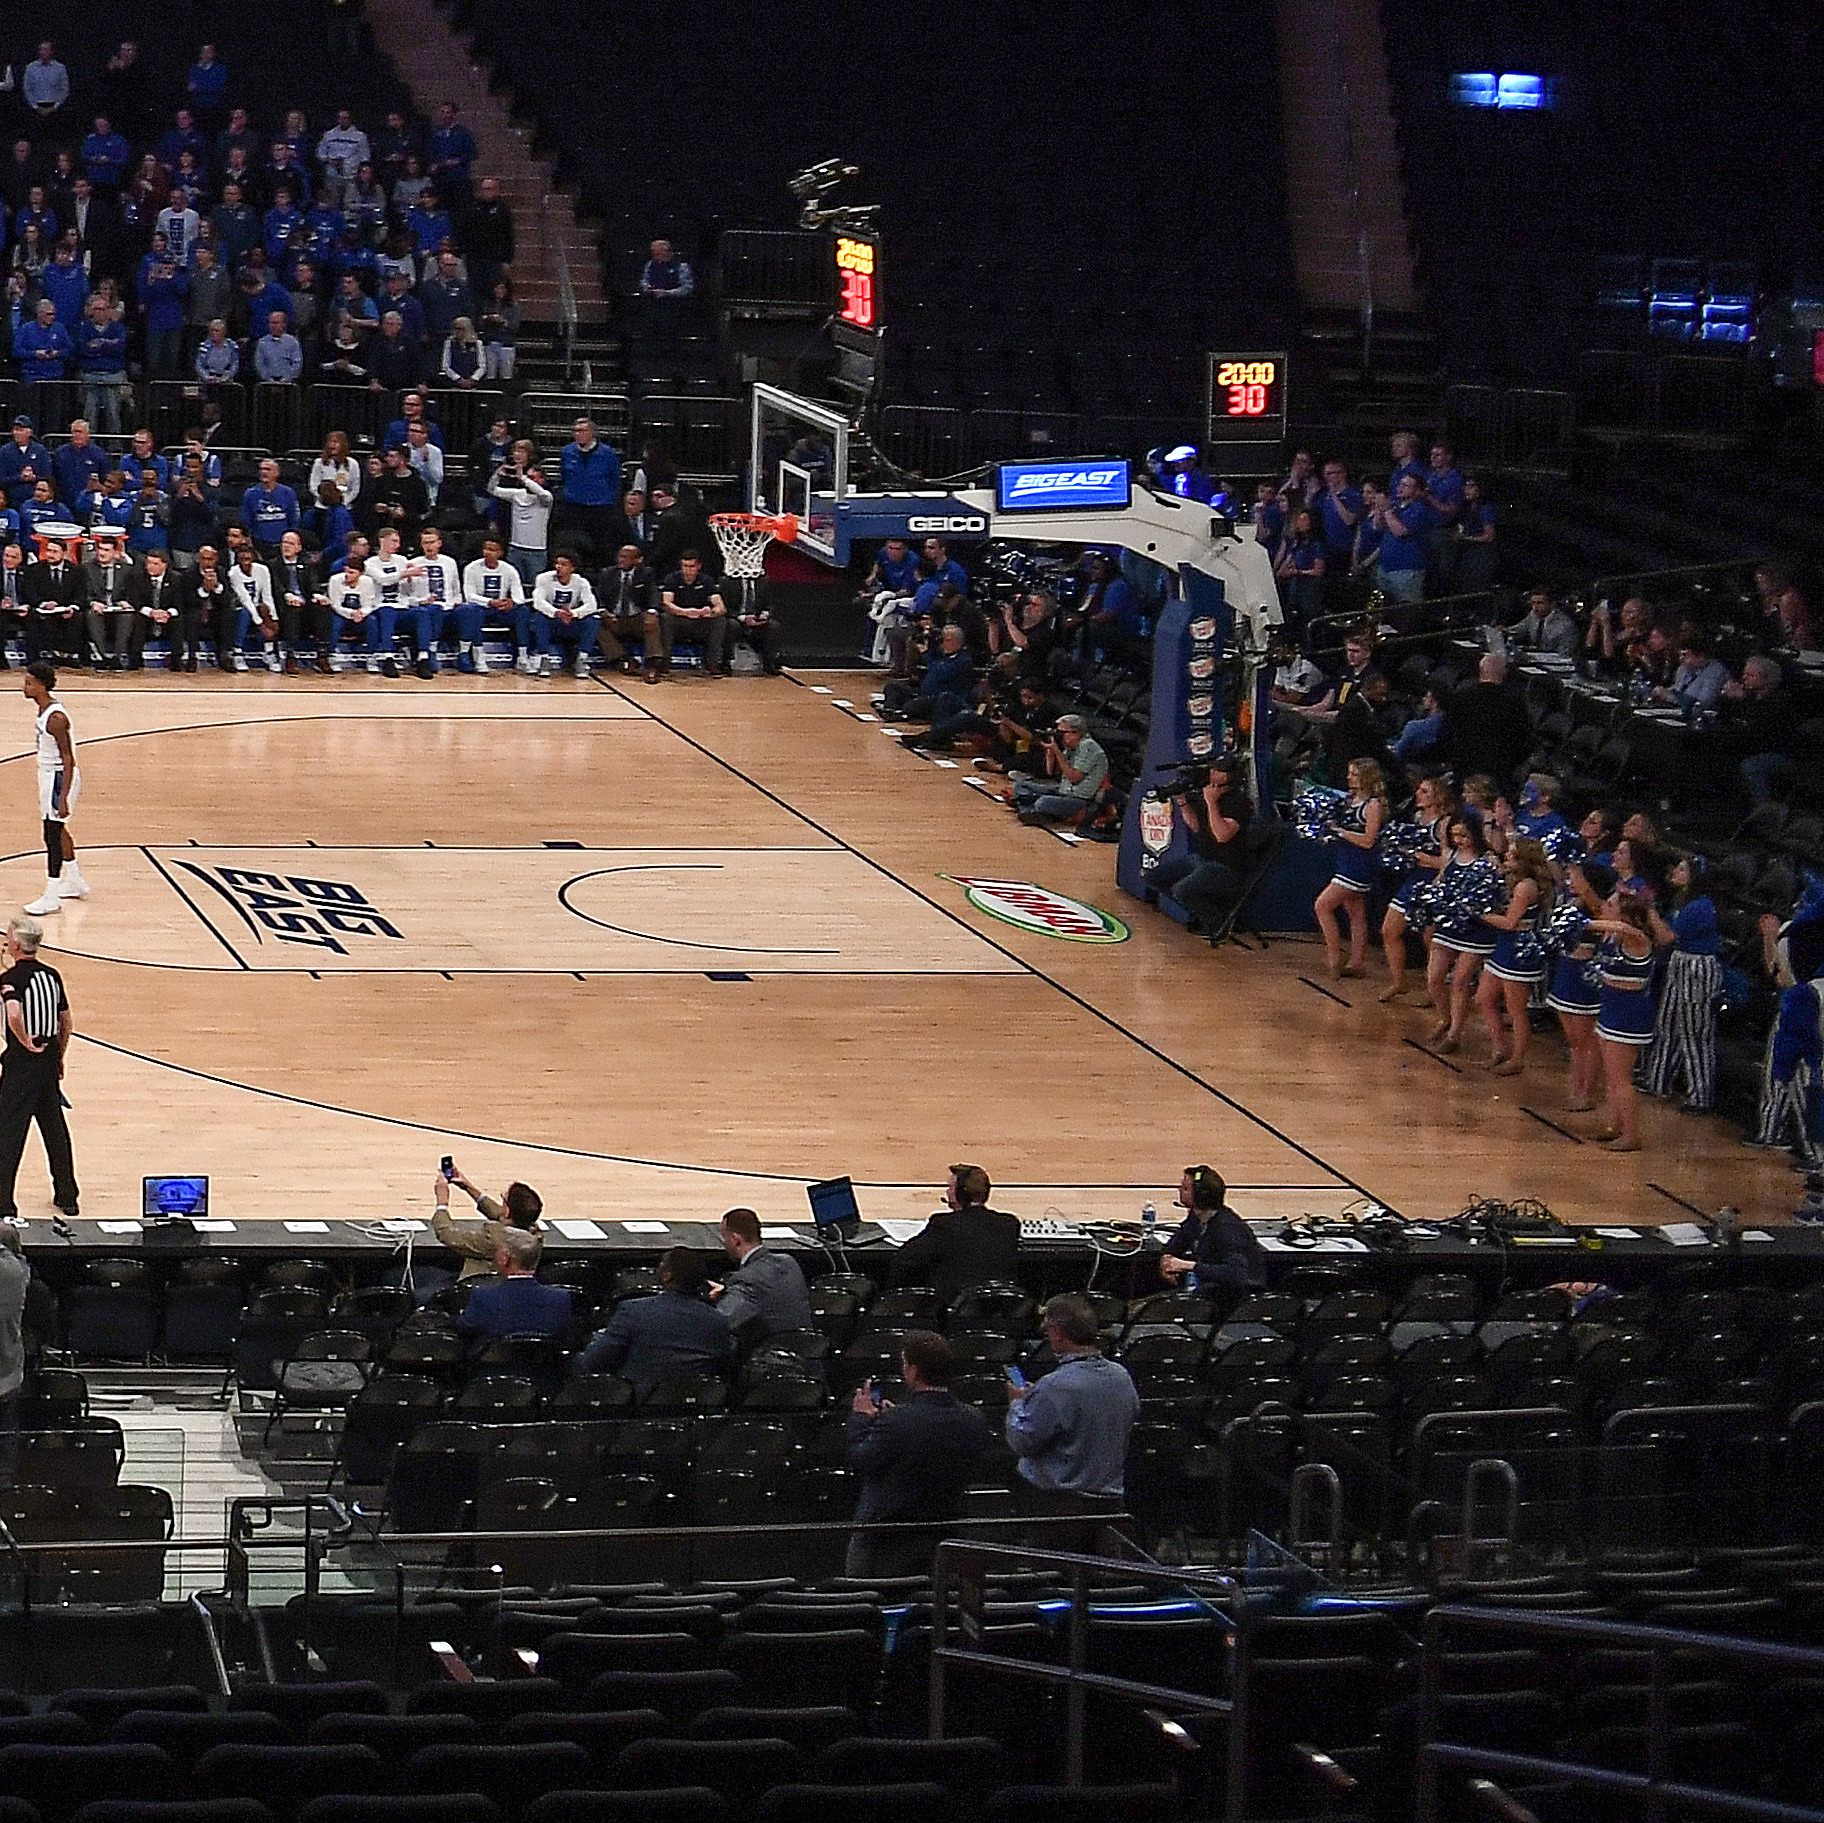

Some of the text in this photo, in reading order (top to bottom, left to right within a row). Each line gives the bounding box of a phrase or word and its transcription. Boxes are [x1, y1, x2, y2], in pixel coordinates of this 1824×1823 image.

[839, 269, 872, 325] 30
[1217, 362, 1275, 387] 20:00
[1227, 384, 1266, 415] 30
[907, 514, 986, 534] GEICO
[213, 865, 352, 956] EAST
[283, 875, 406, 939] BIG
[953, 876, 1113, 938] LIBMAN
